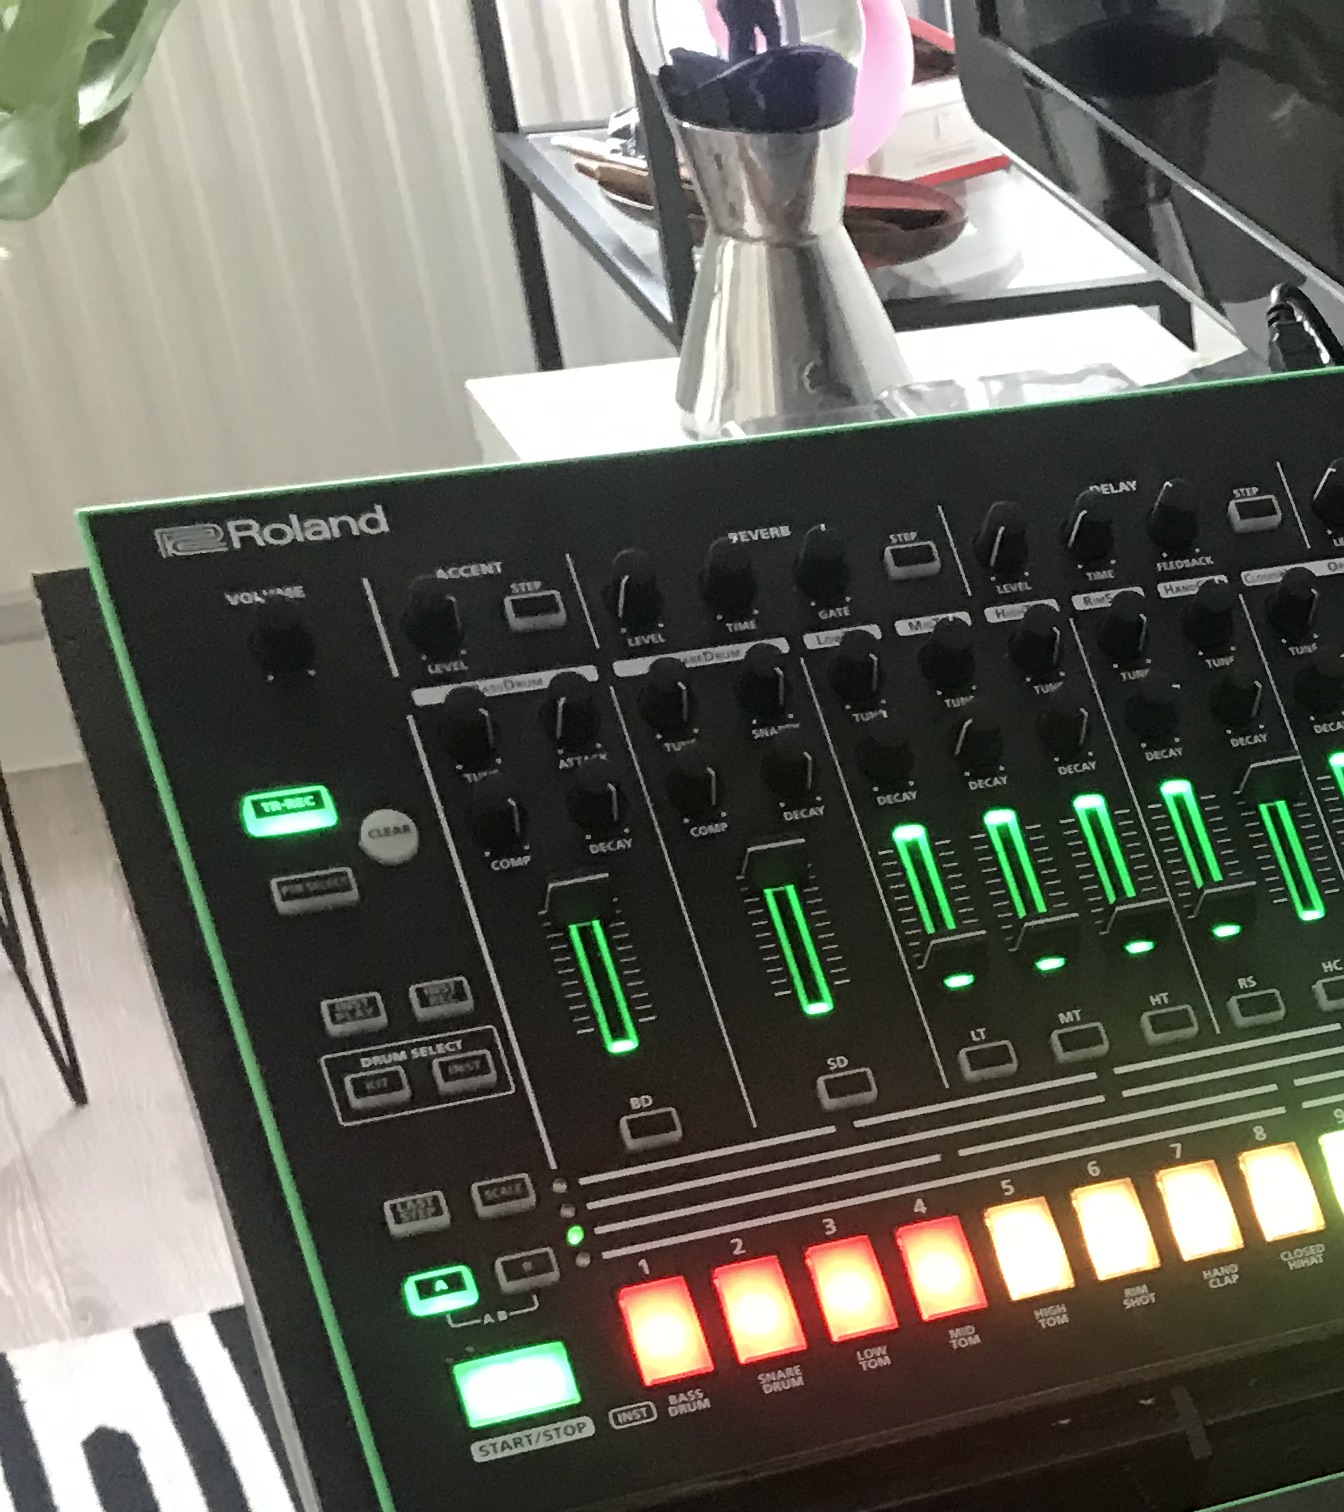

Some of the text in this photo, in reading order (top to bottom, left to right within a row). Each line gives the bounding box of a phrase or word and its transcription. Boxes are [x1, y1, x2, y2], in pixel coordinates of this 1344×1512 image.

[225, 503, 390, 549] Roland
[889, 531, 918, 544] STEP
[435, 561, 503, 580] ACCENT
[1156, 555, 1214, 572] FEEDBACK
[817, 606, 851, 620] GATE
[726, 619, 758, 633] TIME
[627, 633, 666, 648] LEVEL
[260, 795, 316, 813] TR-REC
[367, 823, 412, 840] CLEAR
[690, 822, 729, 838] COMP
[588, 838, 633, 855] DECAY
[1322, 959, 1344, 973] HC
[1238, 976, 1257, 989] RS
[1149, 992, 1170, 1006] HT
[1057, 1008, 1083, 1024] MT
[970, 1028, 988, 1042] LT
[360, 1038, 465, 1068] DRUM SELECT
[826, 1055, 849, 1070] SD
[629, 1095, 654, 1109] BD
[1252, 1126, 1267, 1141] 8
[730, 1238, 747, 1254] 2
[1279, 1243, 1326, 1262] CLOSED
[638, 1258, 650, 1274] 1
[1287, 1252, 1324, 1270] HIHAT
[1034, 1304, 1067, 1320] HIGH
[1038, 1313, 1070, 1329] TOM
[948, 1324, 976, 1339] MID
[949, 1334, 982, 1349] TOM
[856, 1345, 888, 1361] LOW
[859, 1355, 892, 1371] TOM
[757, 1364, 802, 1384] SNARE
[761, 1375, 805, 1395] DRUM
[667, 1388, 704, 1405] BASS
[617, 1406, 649, 1424] INST
[668, 1398, 711, 1417] DRUM
[478, 1420, 588, 1458] START/STOP
